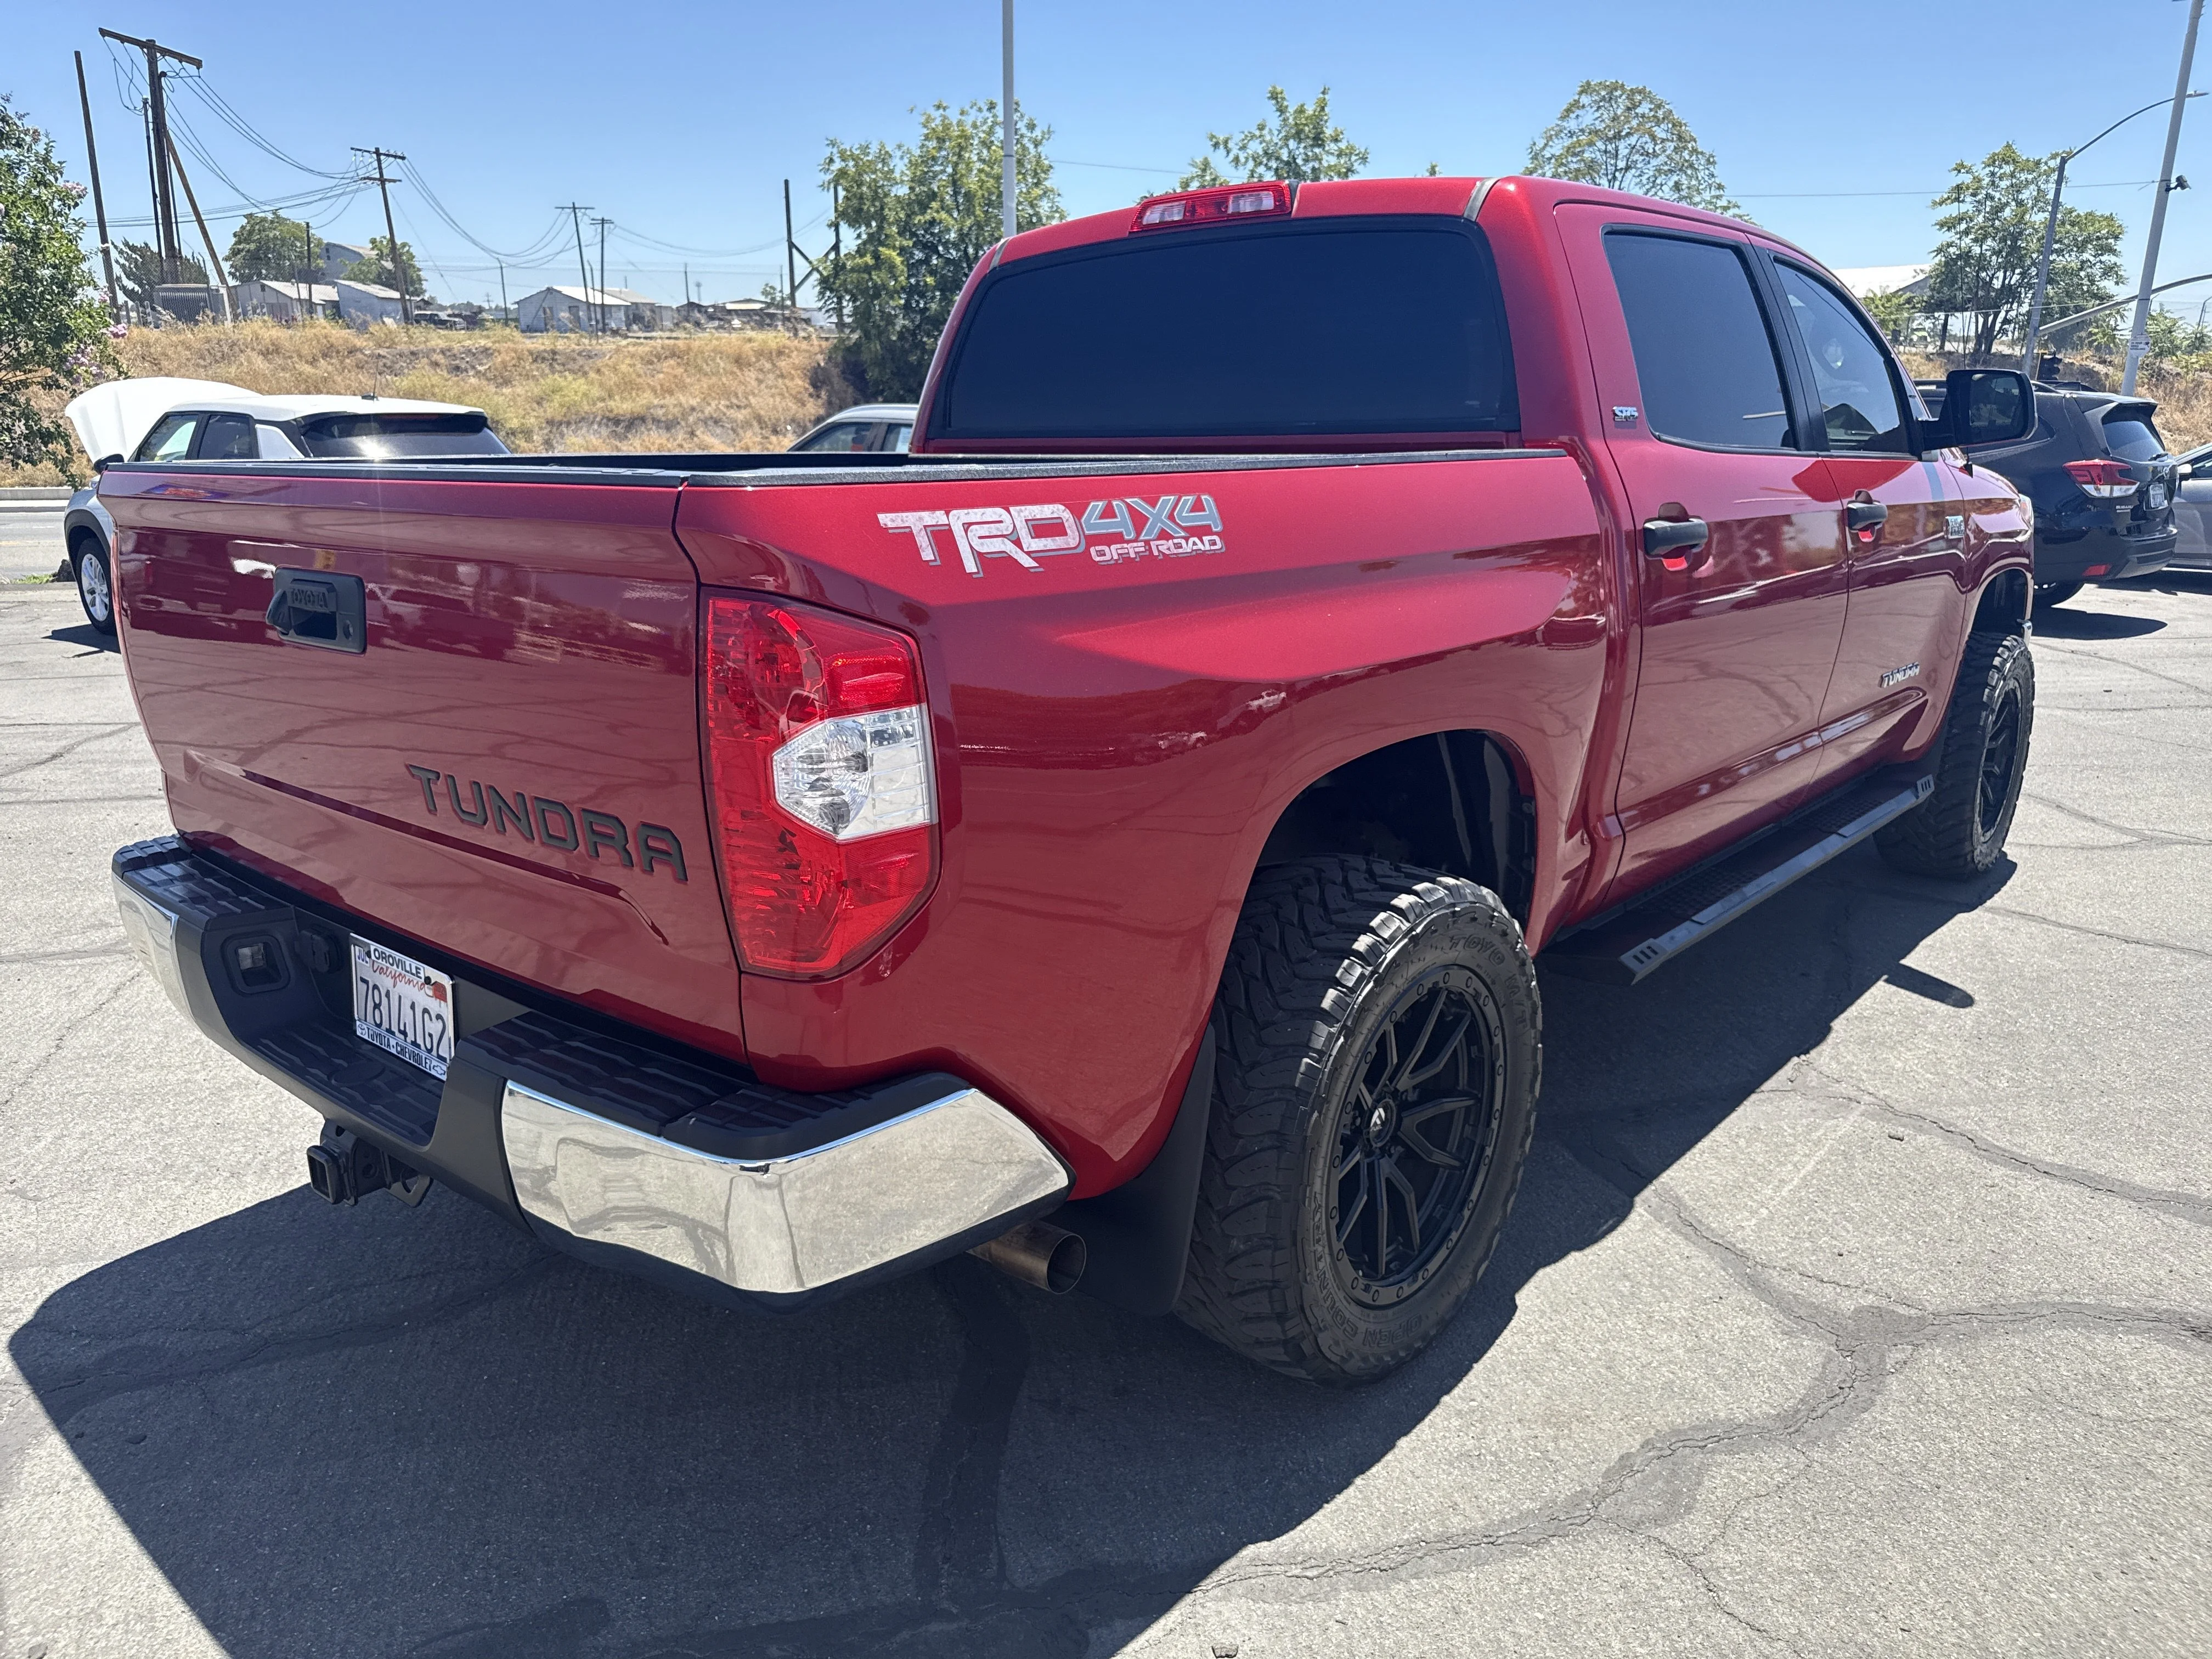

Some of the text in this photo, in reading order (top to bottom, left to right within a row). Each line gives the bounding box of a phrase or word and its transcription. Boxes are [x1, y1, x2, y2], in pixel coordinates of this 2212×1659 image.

[877, 495, 1223, 578] TRD 4X4
[1089, 534, 1225, 564] OFF ROAD
[291, 588, 329, 608] TOYOTA
[1881, 661, 1920, 688] TUNDRA
[405, 764, 689, 882] TUNDRA
[372, 960, 426, 992] California
[373, 947, 422, 980] OROVILLE
[360, 976, 447, 1063] 78141G2
[366, 1028, 432, 1071] TOYOTA CHEVROLET
[1363, 1314, 1423, 1348] OPEN
